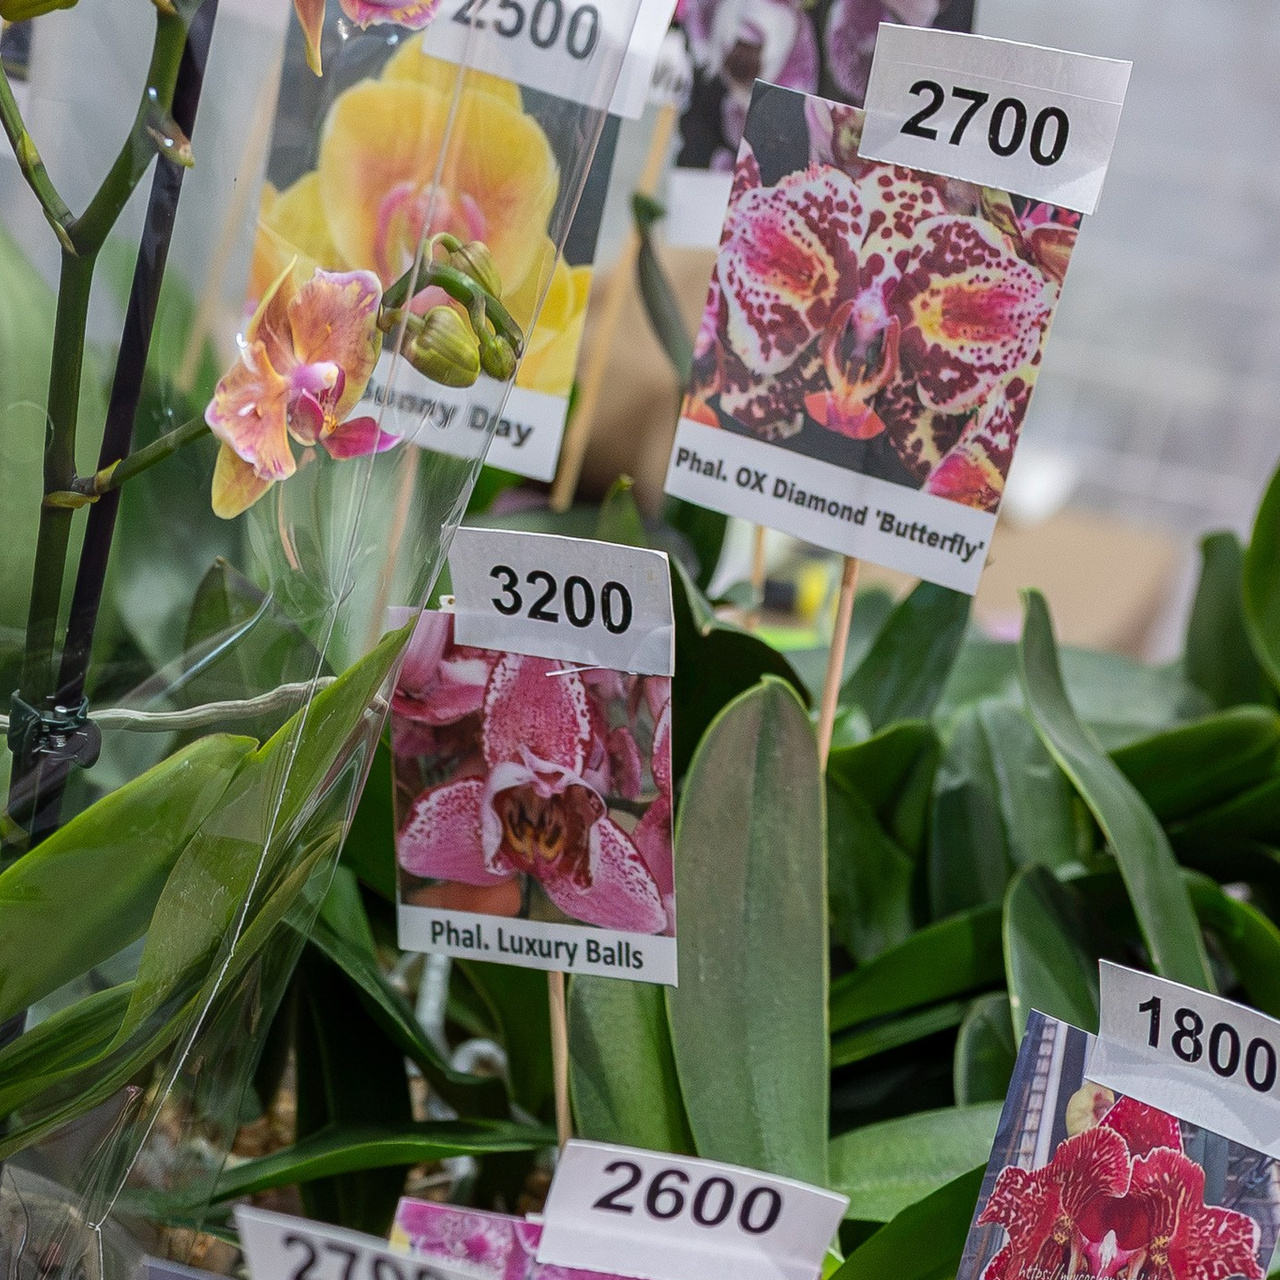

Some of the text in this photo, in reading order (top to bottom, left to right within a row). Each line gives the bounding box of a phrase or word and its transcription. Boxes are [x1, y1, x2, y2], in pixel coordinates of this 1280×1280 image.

[900, 80, 1069, 166] 2700
[467, 405, 535, 447] Day
[676, 447, 985, 562] Phal. OX Diamond 'Butterfly'
[488, 564, 633, 635] 3200
[431, 920, 643, 970] Phal. Luxury Balls
[1138, 995, 1277, 1093] 1800
[592, 1160, 782, 1235] 2600
